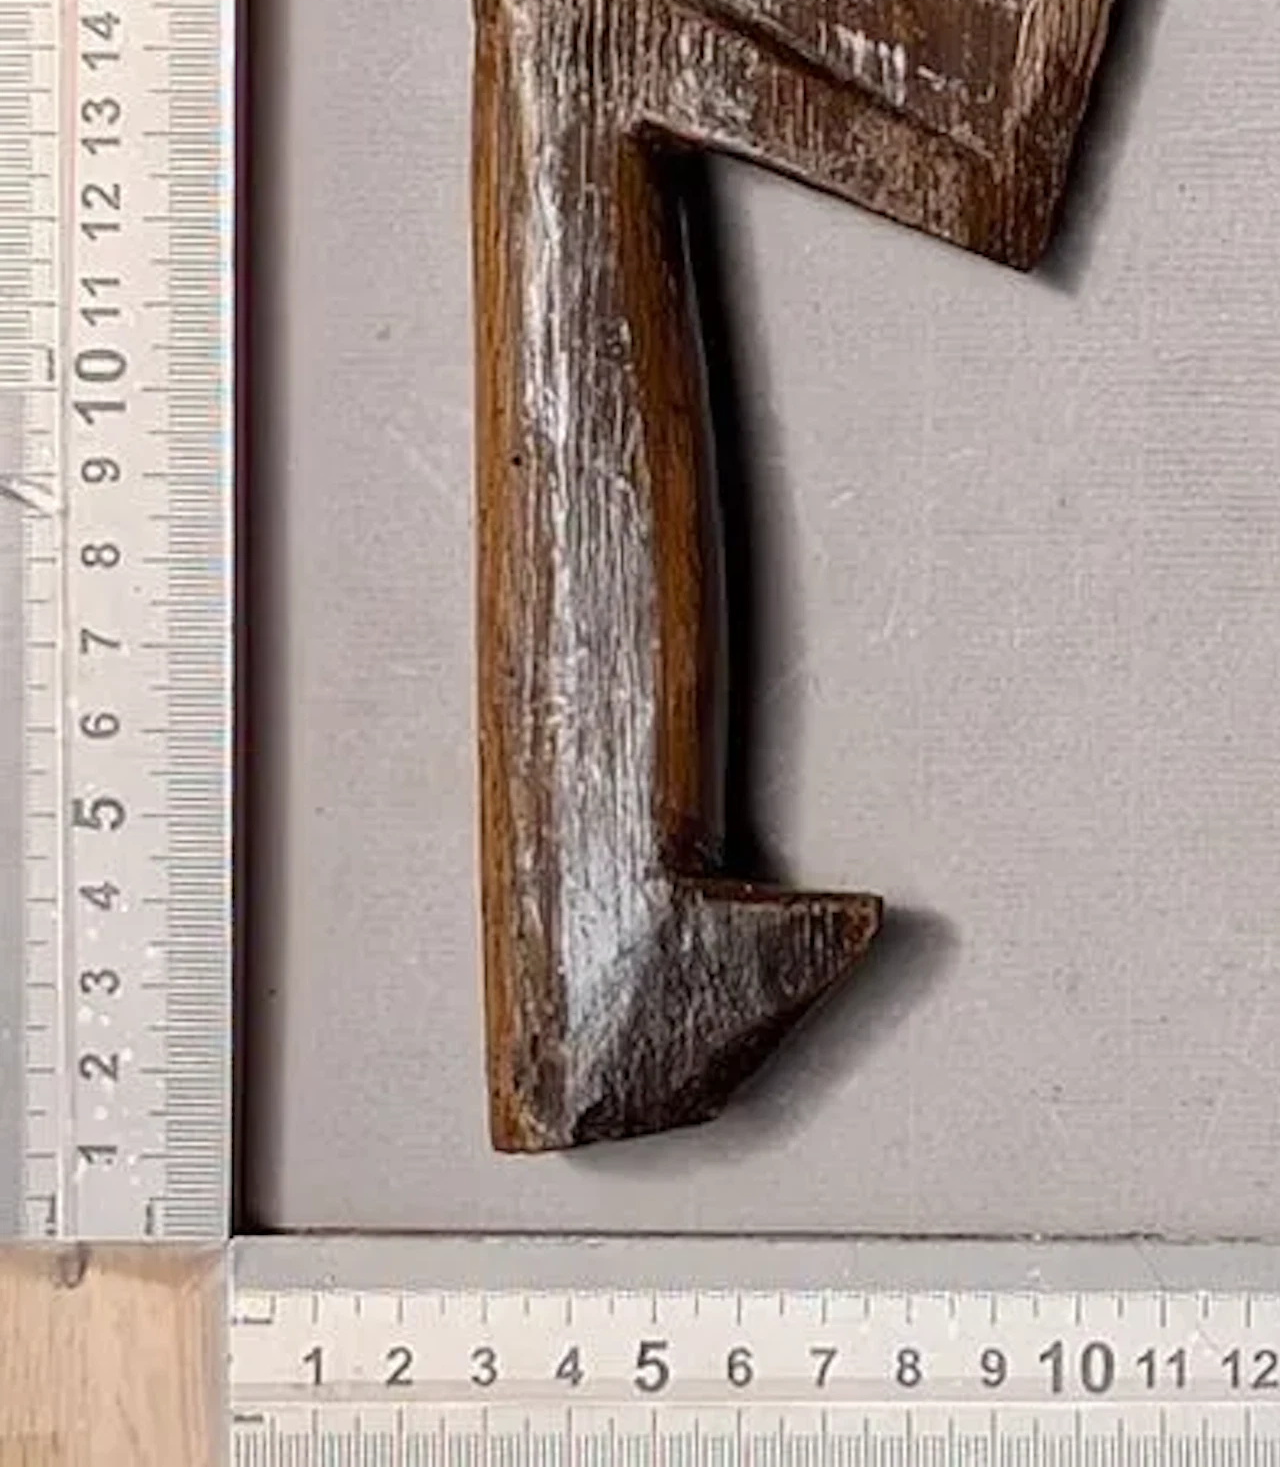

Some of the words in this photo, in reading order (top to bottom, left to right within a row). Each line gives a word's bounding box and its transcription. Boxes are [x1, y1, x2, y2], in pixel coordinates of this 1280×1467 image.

[80, 12, 120, 70] 14
[80, 98, 121, 154] 13
[80, 184, 121, 240] 12
[79, 278, 121, 326] 11
[72, 350, 127, 425] 10
[81, 458, 121, 483] 9
[80, 544, 121, 568] 8
[79, 629, 121, 654] 7
[79, 713, 120, 738] 6
[72, 797, 126, 831] 5
[78, 882, 120, 910] 4
[79, 970, 120, 995] 3
[77, 1054, 120, 1081] 2
[76, 1146, 117, 1168] 1
[304, 1346, 327, 1388] 1
[384, 1346, 414, 1388] 2
[472, 1347, 497, 1388] 3
[556, 1346, 583, 1388] 4
[635, 1339, 668, 1396] 5
[728, 1347, 752, 1388] 6
[811, 1347, 837, 1388] 7
[896, 1347, 922, 1388] 8
[981, 1348, 1006, 1388] 9
[1040, 1340, 1114, 1397] 10
[1137, 1347, 1185, 1390] 11
[1223, 1348, 1279, 1391] 12
